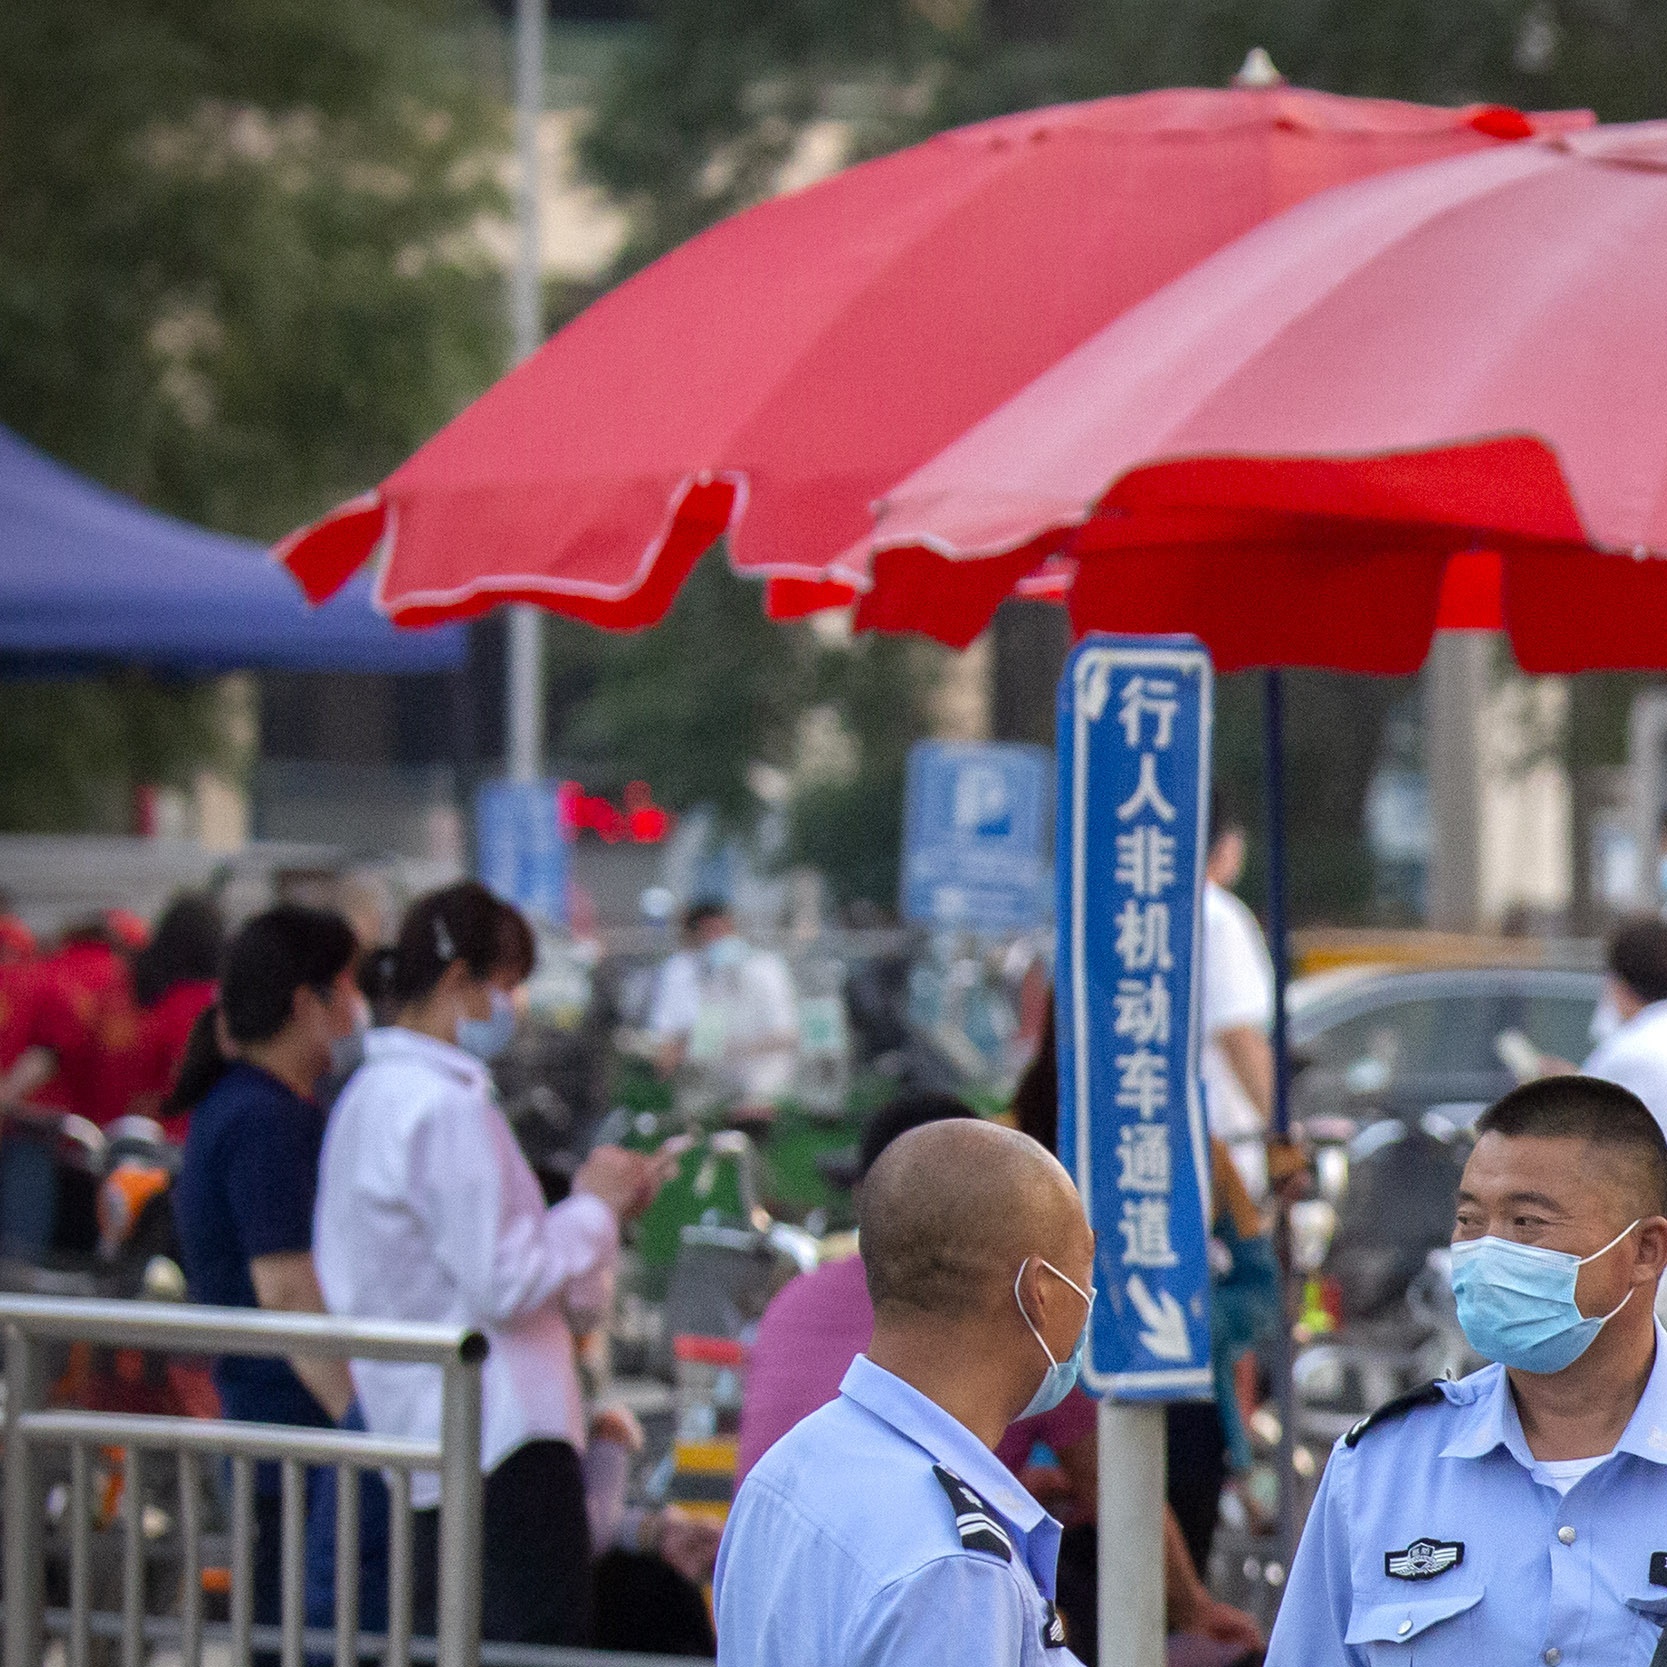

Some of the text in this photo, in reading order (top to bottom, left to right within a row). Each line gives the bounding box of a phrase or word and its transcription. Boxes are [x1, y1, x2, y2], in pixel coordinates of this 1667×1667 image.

[1113, 676, 1179, 1268] 行人非机动车通道
